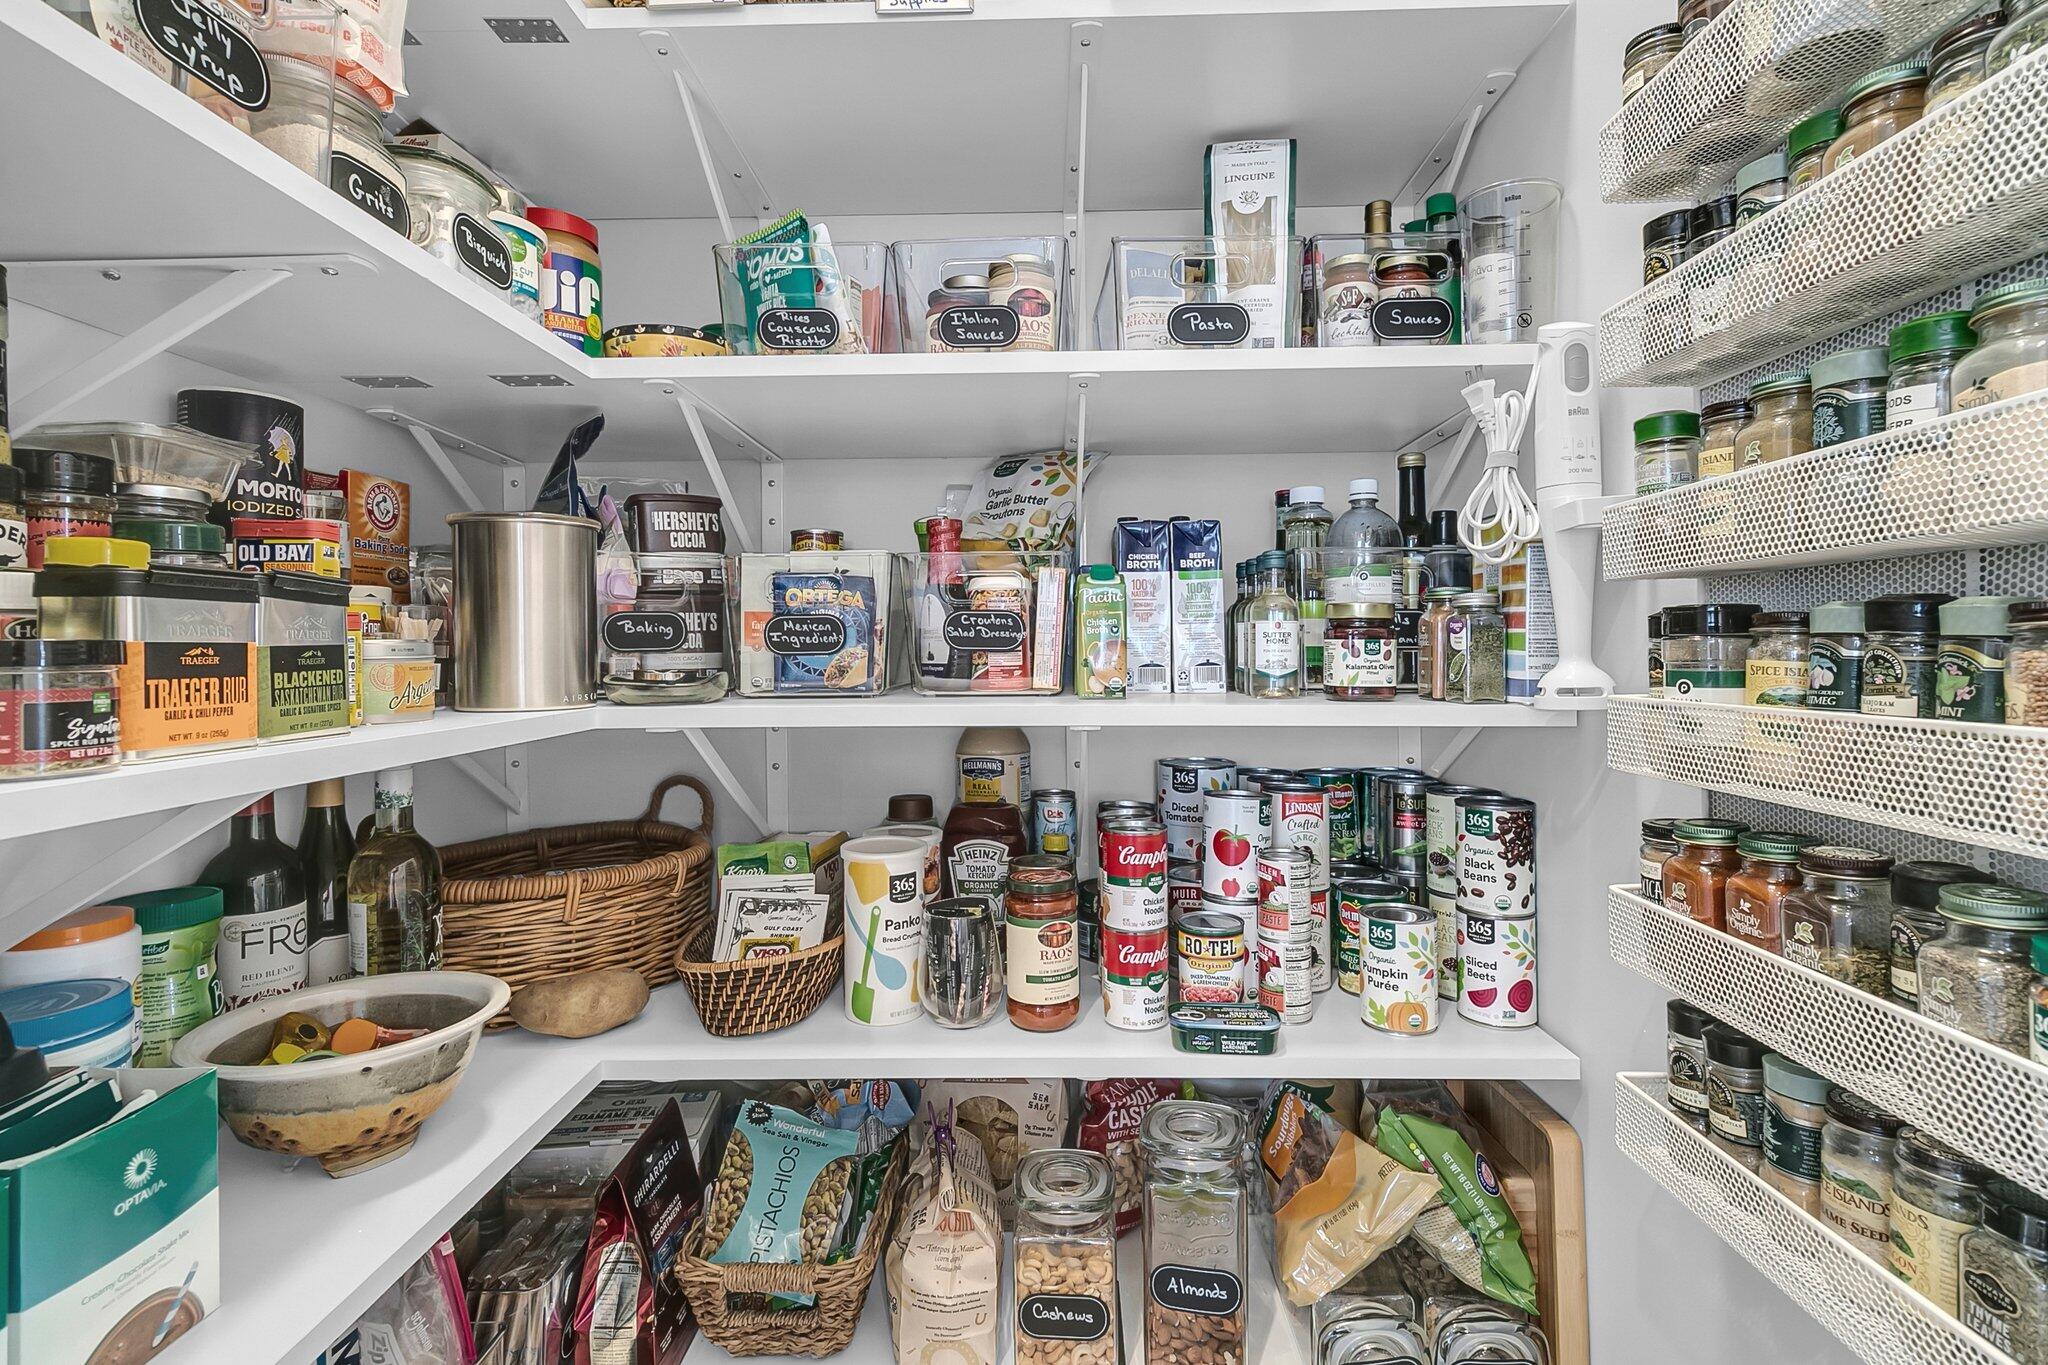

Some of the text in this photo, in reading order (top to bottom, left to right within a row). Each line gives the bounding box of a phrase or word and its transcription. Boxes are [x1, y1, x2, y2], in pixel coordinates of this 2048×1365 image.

[105, 22, 167, 75] MAPLE SYRUP
[162, 26, 244, 95] Syrup
[1224, 172, 1275, 184] LINGUINE
[348, 174, 394, 220] Grits
[461, 226, 507, 274] Bisquick
[519, 266, 534, 278] CUT
[775, 311, 811, 324] Rices
[950, 311, 1000, 326] Italian
[1127, 312, 1166, 322] PENNE
[1182, 312, 1234, 332] Pasta
[1390, 308, 1442, 325] Sauces
[767, 322, 832, 334] Couscous
[956, 328, 1005, 341] Sauces
[776, 334, 827, 347] Risotto
[1567, 407, 1590, 416] BRAUN
[987, 486, 1012, 499] Organic
[228, 500, 293, 517] IODIZED
[985, 494, 1049, 511] Garlic Butter
[982, 507, 1026, 519] Croutons
[652, 510, 719, 533] HERSHEY'S
[354, 538, 409, 555] Baking Soda
[669, 531, 707, 549] COCOA
[238, 543, 310, 562] OLD BAY
[1128, 553, 1160, 561] CHICKEN
[1188, 551, 1206, 560] BEEF
[264, 562, 314, 572] SEASONING
[1126, 559, 1162, 570] BROTH
[1180, 558, 1216, 569] BROTH
[1131, 578, 1157, 591] 100%
[1186, 581, 1213, 595] 100%
[784, 587, 867, 610] ORTEGA
[1079, 587, 1126, 605] Pacific
[783, 610, 832, 623] Mexican
[961, 614, 1014, 627] Croutons
[1086, 618, 1118, 629] Chicken
[286, 627, 332, 641] TRAEGER
[616, 619, 674, 641] Baking
[769, 622, 844, 639] Ingredients
[947, 626, 1027, 641] Salad Dressings
[1086, 627, 1109, 636] Broth
[1262, 631, 1293, 639] SUTTER
[1266, 637, 1290, 646] HOME
[1366, 641, 1381, 652] 365
[179, 656, 221, 665] TRAEGER
[297, 657, 326, 666] TRAEGER
[1345, 663, 1378, 671] Kalamata
[1750, 664, 1782, 677] SPICE
[273, 669, 344, 690] BLACKENED
[146, 676, 247, 709] TRAEGER RUB
[274, 686, 331, 707] SASKATCHEWAN
[164, 706, 234, 720] GARLIC CHILI PEPPER
[280, 708, 297, 717] GARLIC
[1937, 705, 1966, 718] MINT
[50, 740, 80, 749] SPICE
[168, 734, 181, 742] NET
[963, 759, 1002, 772] HELLMANN'S
[1173, 770, 1197, 786] 365
[971, 782, 992, 791] REAL
[1171, 801, 1200, 814] Diced
[1284, 801, 1323, 817] LINDSAY
[1287, 818, 1321, 832] Crafted
[1332, 822, 1348, 831] CUT
[1466, 813, 1491, 829] 365
[1289, 833, 1319, 845] LARGE
[963, 848, 999, 862] HEINZ
[1464, 843, 1496, 856] Organic
[724, 864, 767, 876] Knorr
[965, 864, 997, 874] TOMATO
[1464, 857, 1495, 871] Black
[967, 871, 996, 880] KETCHUP
[1463, 868, 1497, 884] Beans
[891, 875, 916, 895] 365
[964, 880, 999, 889] ORGANIC
[1172, 888, 1198, 900] MUIR
[1142, 896, 1166, 907] Chicken
[1666, 897, 1692, 913] Simply
[1144, 905, 1165, 916] Noodle
[1731, 907, 1761, 926] Simply
[883, 915, 921, 933] Panko
[1147, 918, 1164, 927] SOUP
[1467, 920, 1493, 937] 365
[1729, 918, 1765, 940] Organic
[1370, 924, 1393, 941] 365
[881, 935, 902, 945] Bread
[1039, 947, 1073, 962] RAO'S
[1786, 938, 1822, 960] Simply
[1368, 951, 1397, 965] Organic
[1465, 955, 1498, 971] Sliced
[1784, 949, 1828, 973] Organic
[1190, 960, 1232, 971] Original
[1362, 960, 1409, 981] Pumpkin
[241, 973, 264, 982] RED
[265, 965, 294, 978] BLEND
[1466, 967, 1497, 983] Beets
[1367, 975, 1400, 993] Purée
[1142, 994, 1166, 1006] Chicken
[1144, 1004, 1165, 1015] Noodle
[1923, 995, 1963, 1022] Simply
[1147, 1015, 1164, 1026] SOUP
[1032, 1092, 1049, 1102] SEA
[1109, 1081, 1160, 1108] WHOLE
[1027, 1100, 1050, 1111] SALT
[570, 1110, 631, 1123] EDAMAME
[750, 1111, 770, 1119] Shells
[770, 1118, 827, 1139] Wonderful
[1107, 1129, 1127, 1140] WITH
[1283, 1112, 1298, 1150] Nibblers
[761, 1126, 830, 1149] Sea Salt Vinegar
[1441, 1151, 1455, 1165] NET
[633, 1140, 681, 1208] GHIRARDELLI
[1377, 1159, 1400, 1181] PRETZELS
[113, 1178, 168, 1218] OPTAVIA
[749, 1145, 801, 1263] PISTACHIOS
[1832, 1187, 1890, 1218] ISLANDS
[651, 1201, 684, 1248] ASSORTMENT
[80, 1281, 117, 1307] Creamy
[116, 1251, 156, 1282] Chocolate
[156, 1237, 179, 1258] Shake
[178, 1227, 191, 1241] Mix
[627, 1264, 640, 1274] 180
[1166, 1277, 1228, 1301] Almonds
[1969, 1274, 2011, 1304] PRIVATE
[1033, 1303, 1094, 1324] Cashews
[1967, 1300, 2011, 1339] THYME
[1966, 1312, 2012, 1354] LEAVES
